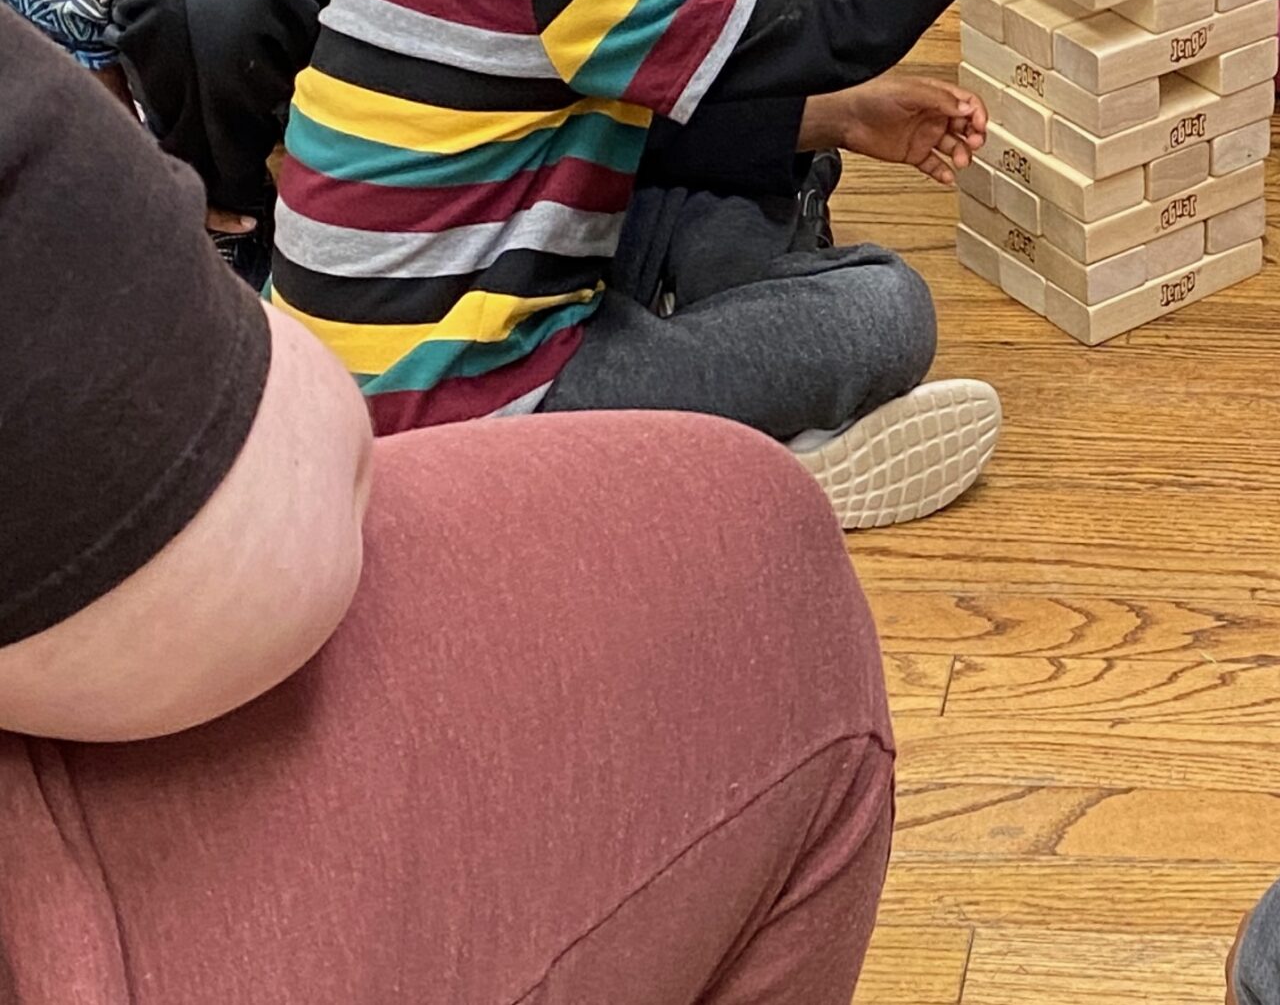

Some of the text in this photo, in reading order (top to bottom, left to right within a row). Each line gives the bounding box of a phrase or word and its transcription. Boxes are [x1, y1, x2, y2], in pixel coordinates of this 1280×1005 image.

[1170, 27, 1207, 62] Jenga
[1170, 114, 1206, 148] Jenga
[1160, 195, 1198, 229] Jenga
[1160, 271, 1195, 307] Jenga
